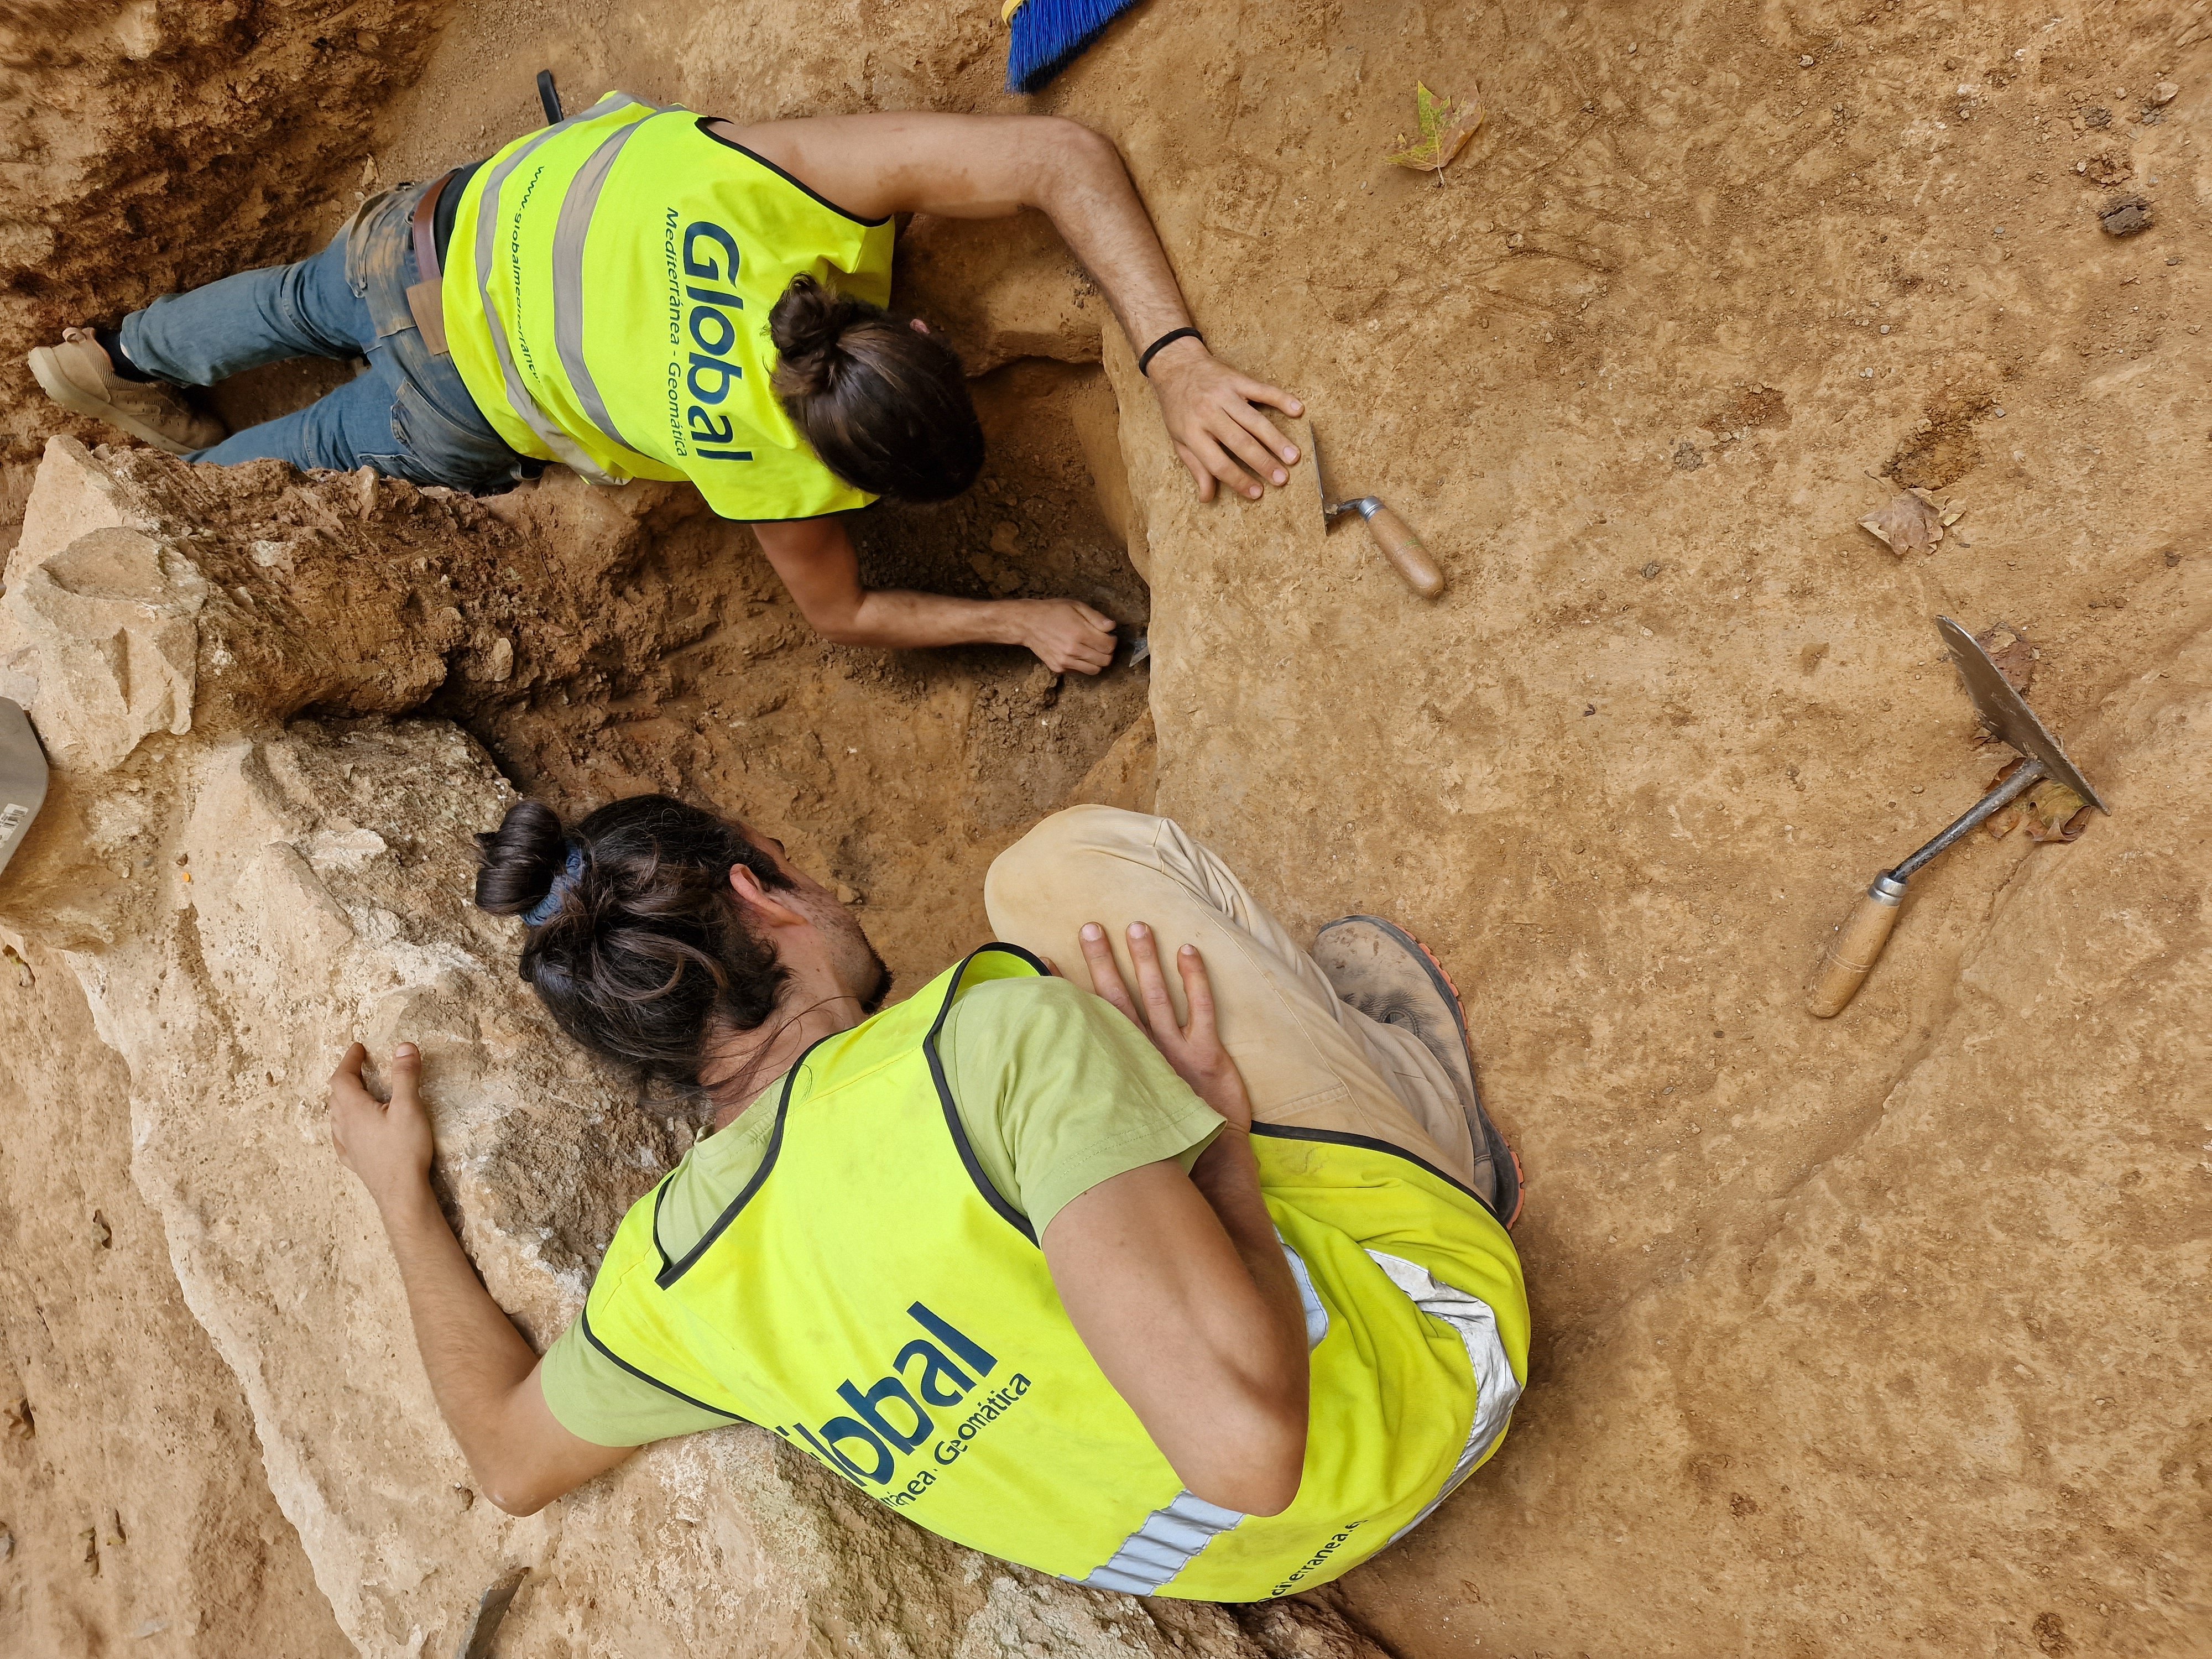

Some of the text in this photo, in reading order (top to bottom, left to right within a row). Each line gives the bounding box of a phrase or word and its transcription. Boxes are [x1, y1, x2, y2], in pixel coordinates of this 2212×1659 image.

[665, 207, 684, 345] Mediterránea
[683, 221, 753, 461] Global
[668, 362, 687, 456] Geomática
[775, 1301, 998, 1486] lobal
[935, 1373, 1032, 1465] Geomática
